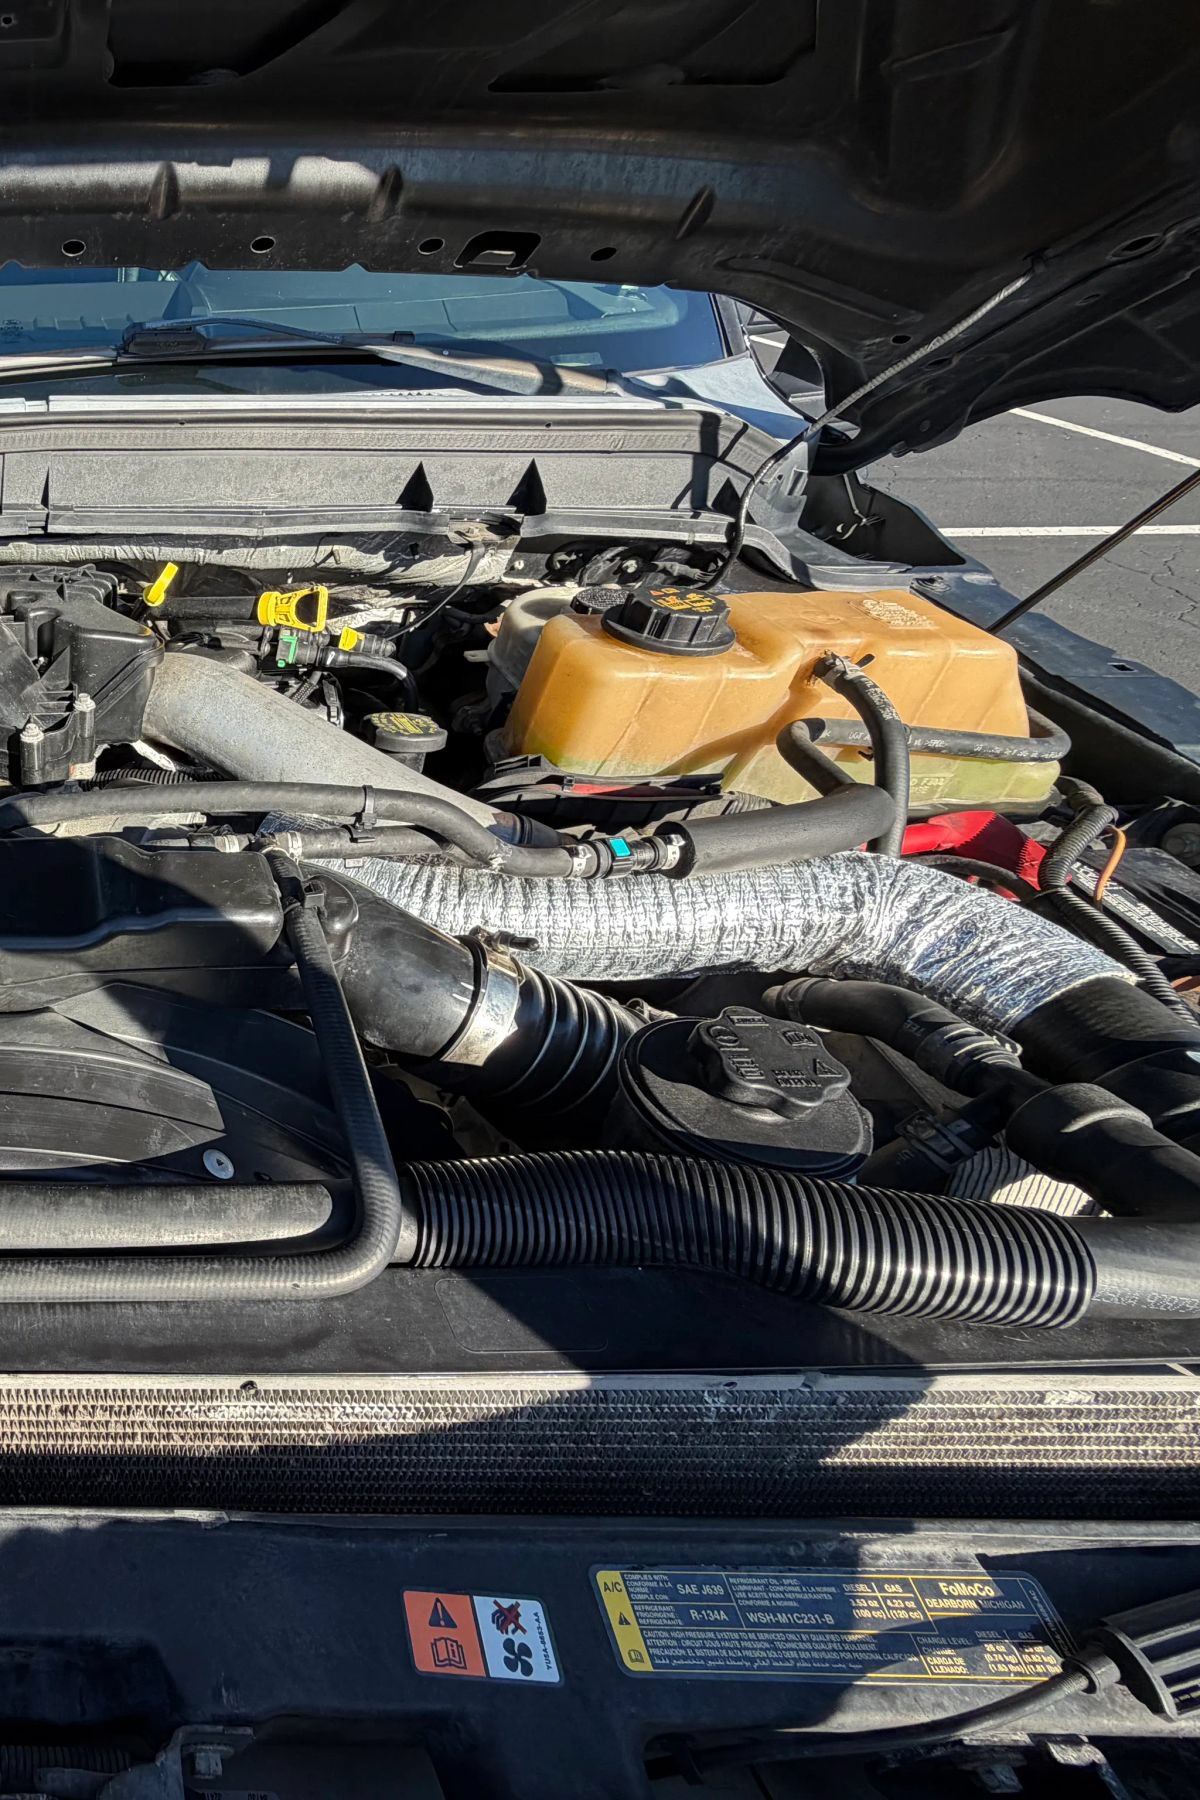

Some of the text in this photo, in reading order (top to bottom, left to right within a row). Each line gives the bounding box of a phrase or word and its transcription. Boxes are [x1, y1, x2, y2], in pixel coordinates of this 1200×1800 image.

[604, 1582, 622, 1593] A/C
[676, 1584, 724, 1596] SAE J639
[842, 1584, 903, 1593] DIESEL GAS
[938, 1582, 996, 1598] FoMoCo
[905, 1600, 916, 1608] oz
[925, 1598, 1026, 1609] DEARBORN MICHIGAN
[690, 1610, 729, 1621] R-134A
[746, 1612, 835, 1624] WSH-M1C231-B
[716, 1632, 741, 1640] SYSTEM
[811, 1634, 841, 1642] QUALIFIED
[975, 1630, 1002, 1638] DIESEL
[916, 1636, 947, 1645] CHARGE
[926, 1657, 953, 1665] CARGA
